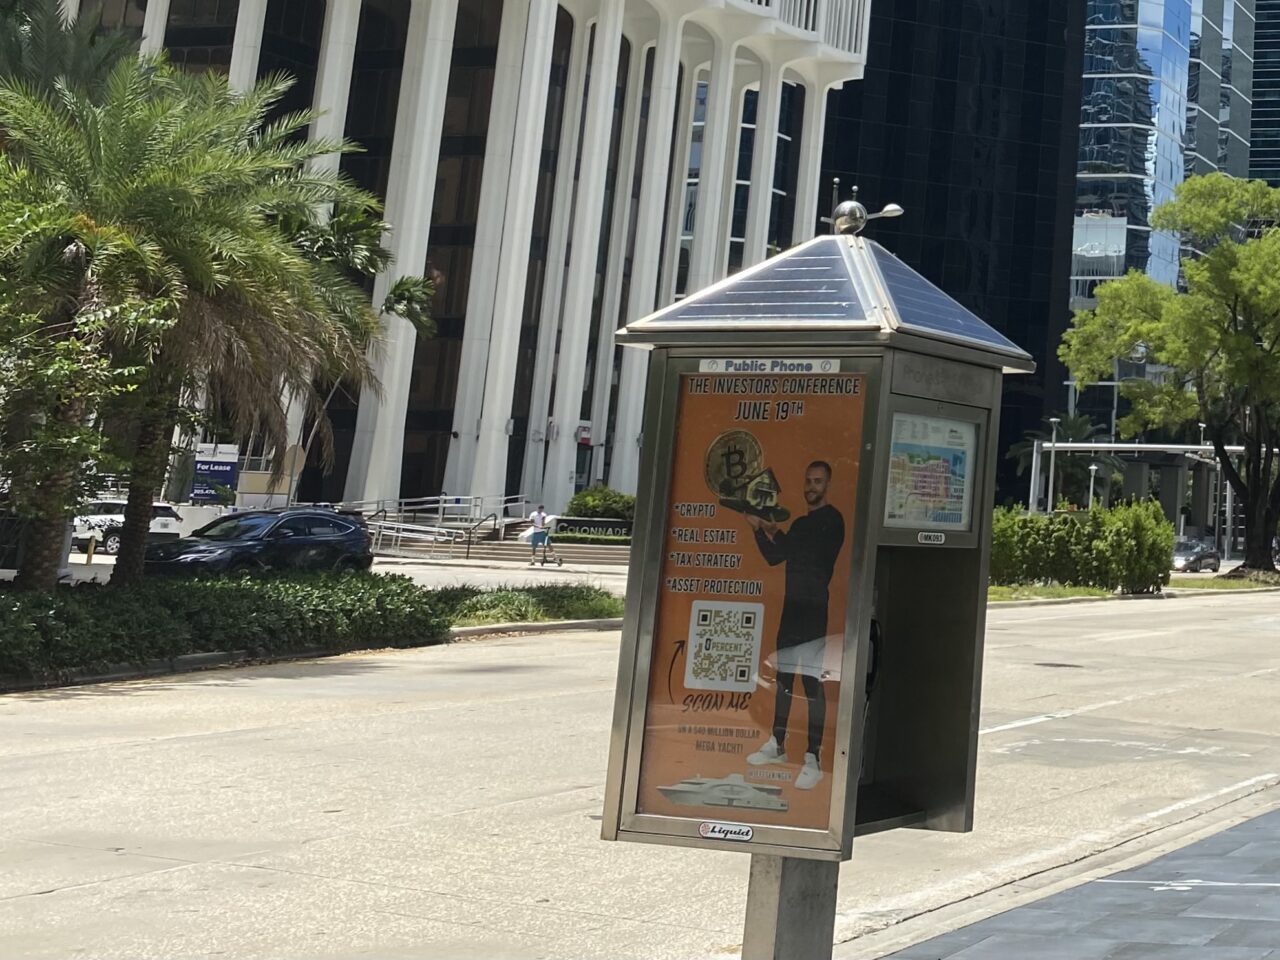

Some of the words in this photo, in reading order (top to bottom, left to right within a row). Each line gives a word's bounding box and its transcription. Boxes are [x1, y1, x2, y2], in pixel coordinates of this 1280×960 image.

[724, 360, 767, 372] Public
[770, 360, 813, 372] Phone
[688, 377, 711, 394] THE
[713, 377, 779, 394] INVESTORS
[782, 377, 860, 395] CONFERENCE
[734, 401, 771, 421] JUNE
[557, 522, 628, 536] COLONNADE
[703, 529, 737, 544] ESTATE
[695, 552, 742, 568] STRATEGY
[703, 579, 763, 595] PROTECTION
[711, 642, 743, 653] PERCENT
[727, 691, 752, 712] ME
[707, 727, 734, 737] MILLION
[735, 729, 760, 739] DOLLAR
[717, 742, 744, 754] YACHT!
[710, 825, 751, 838] Liquid
